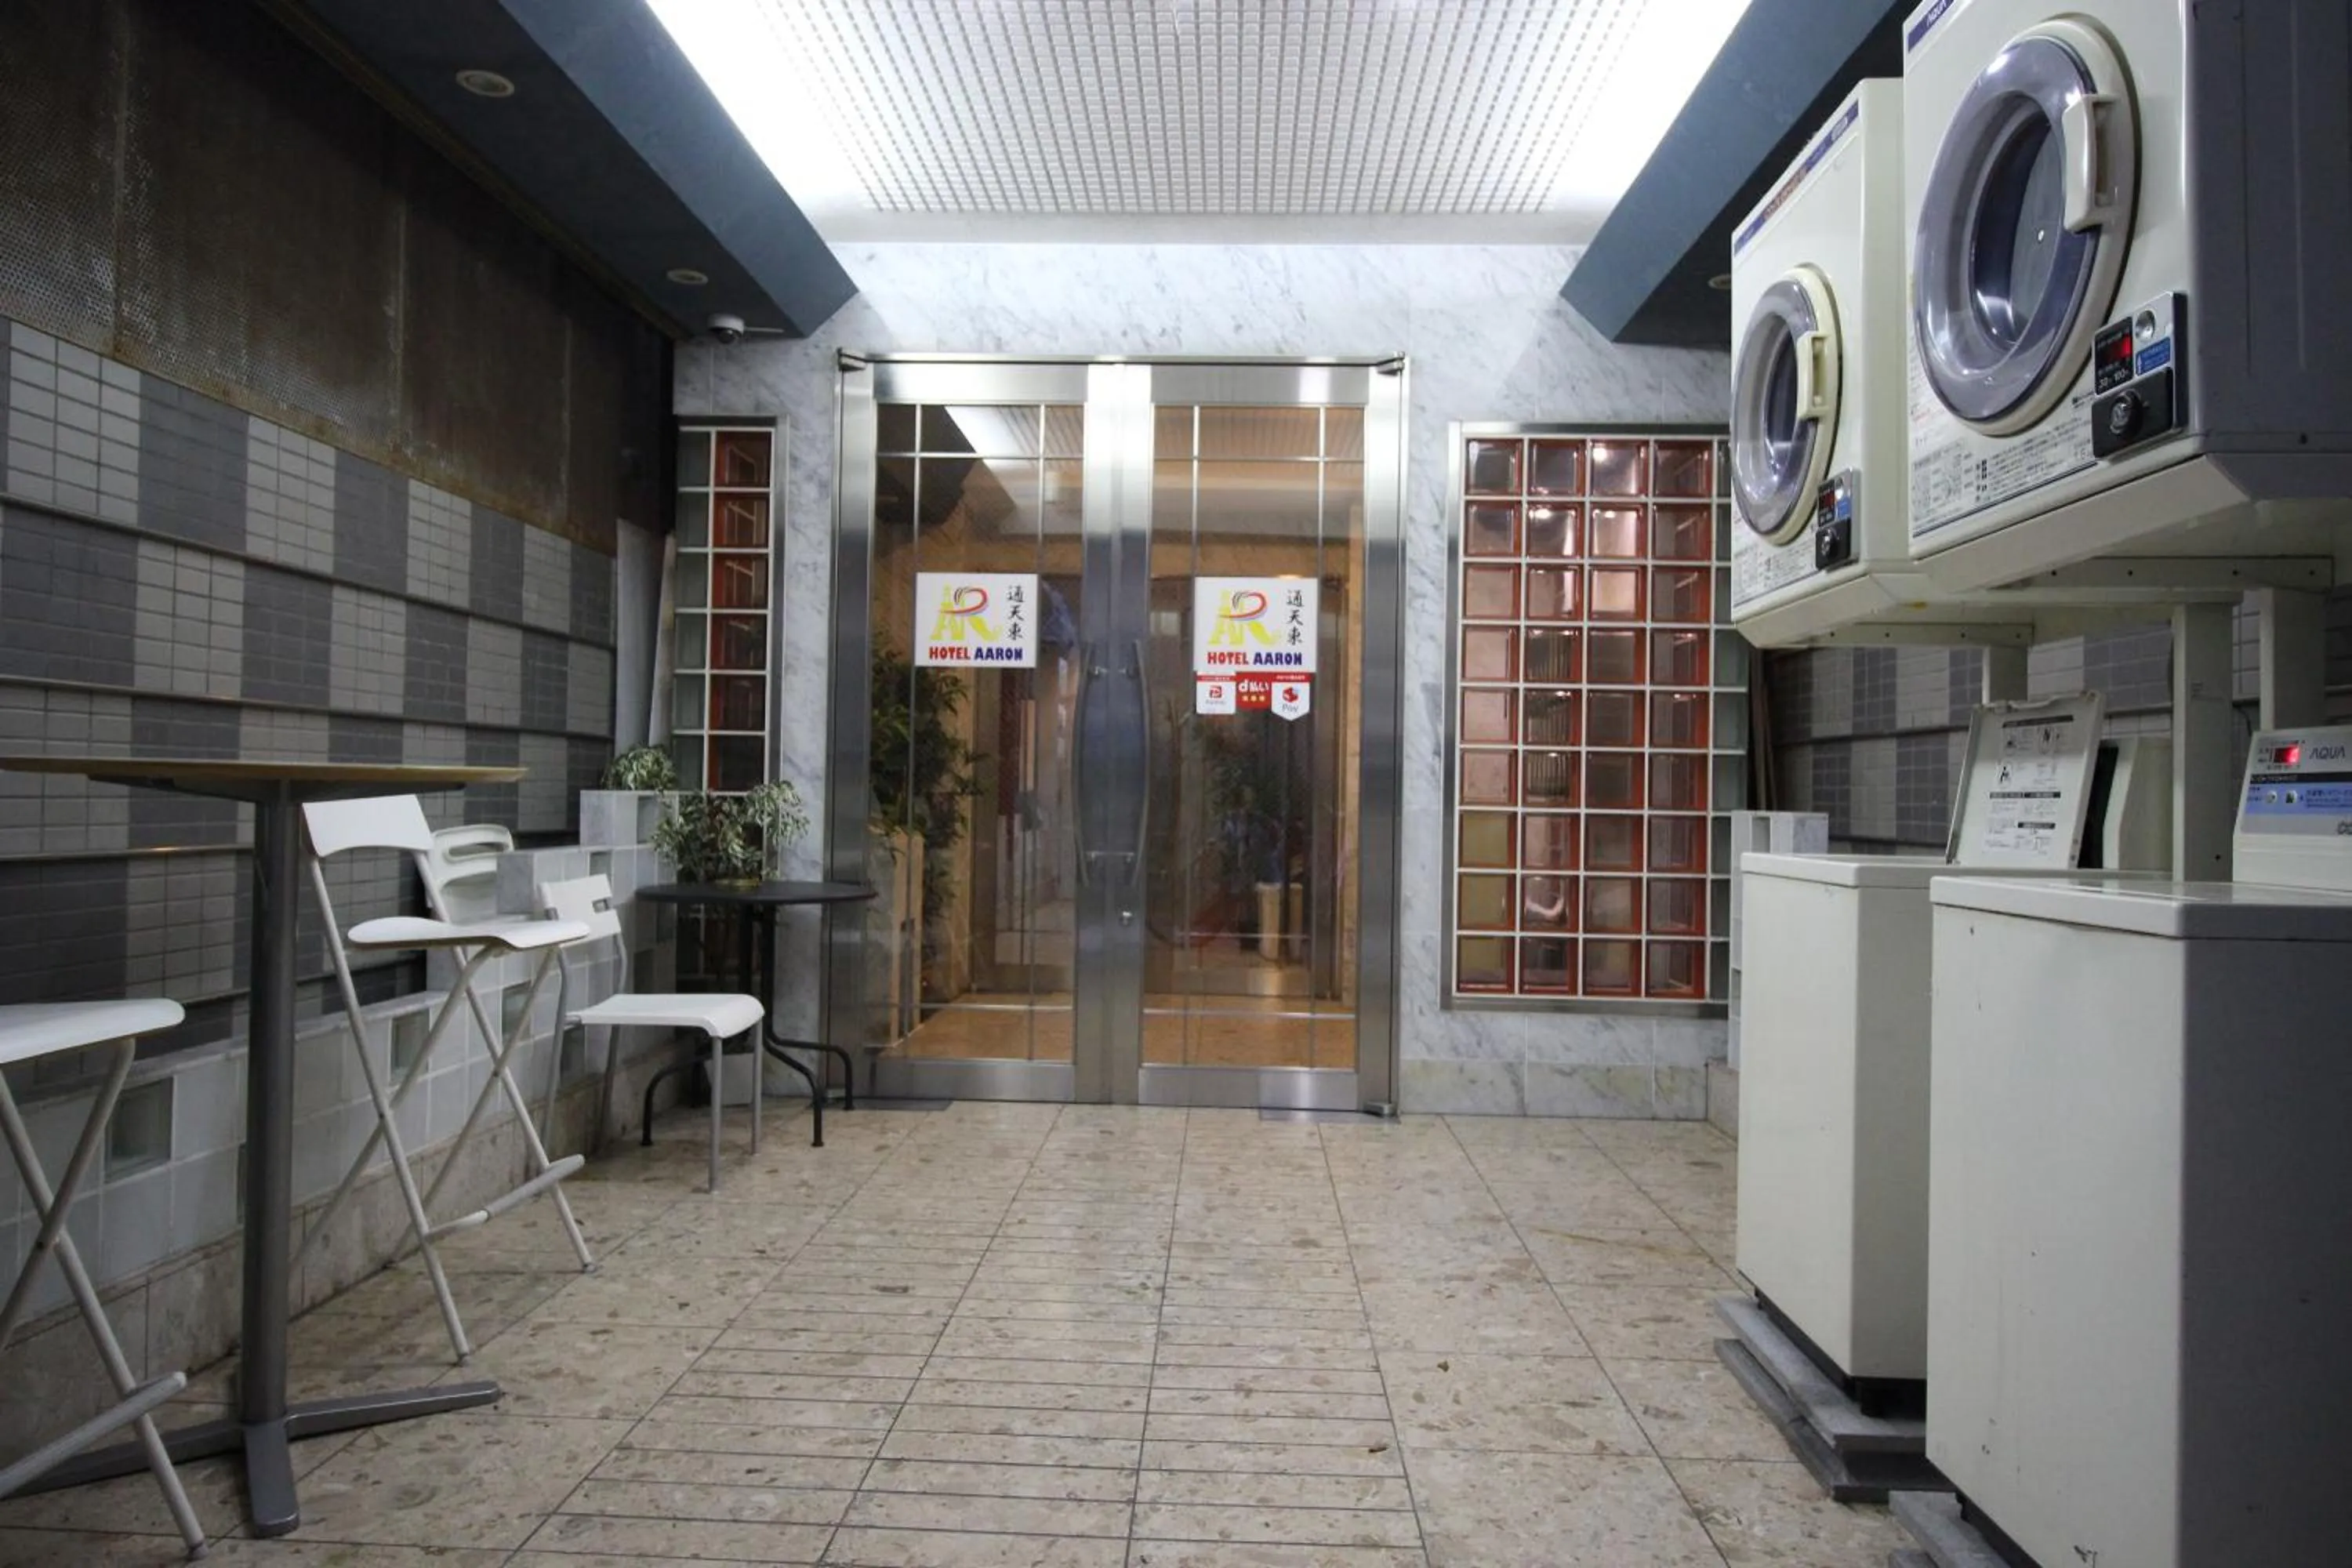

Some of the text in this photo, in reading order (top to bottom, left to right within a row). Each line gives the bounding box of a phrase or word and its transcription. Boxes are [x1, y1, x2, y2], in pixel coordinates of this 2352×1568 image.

[929, 646, 1023, 661] HOTEL AARON
[1207, 652, 1302, 666] HOTEL AARON
[2309, 746, 2346, 760] AQUA
